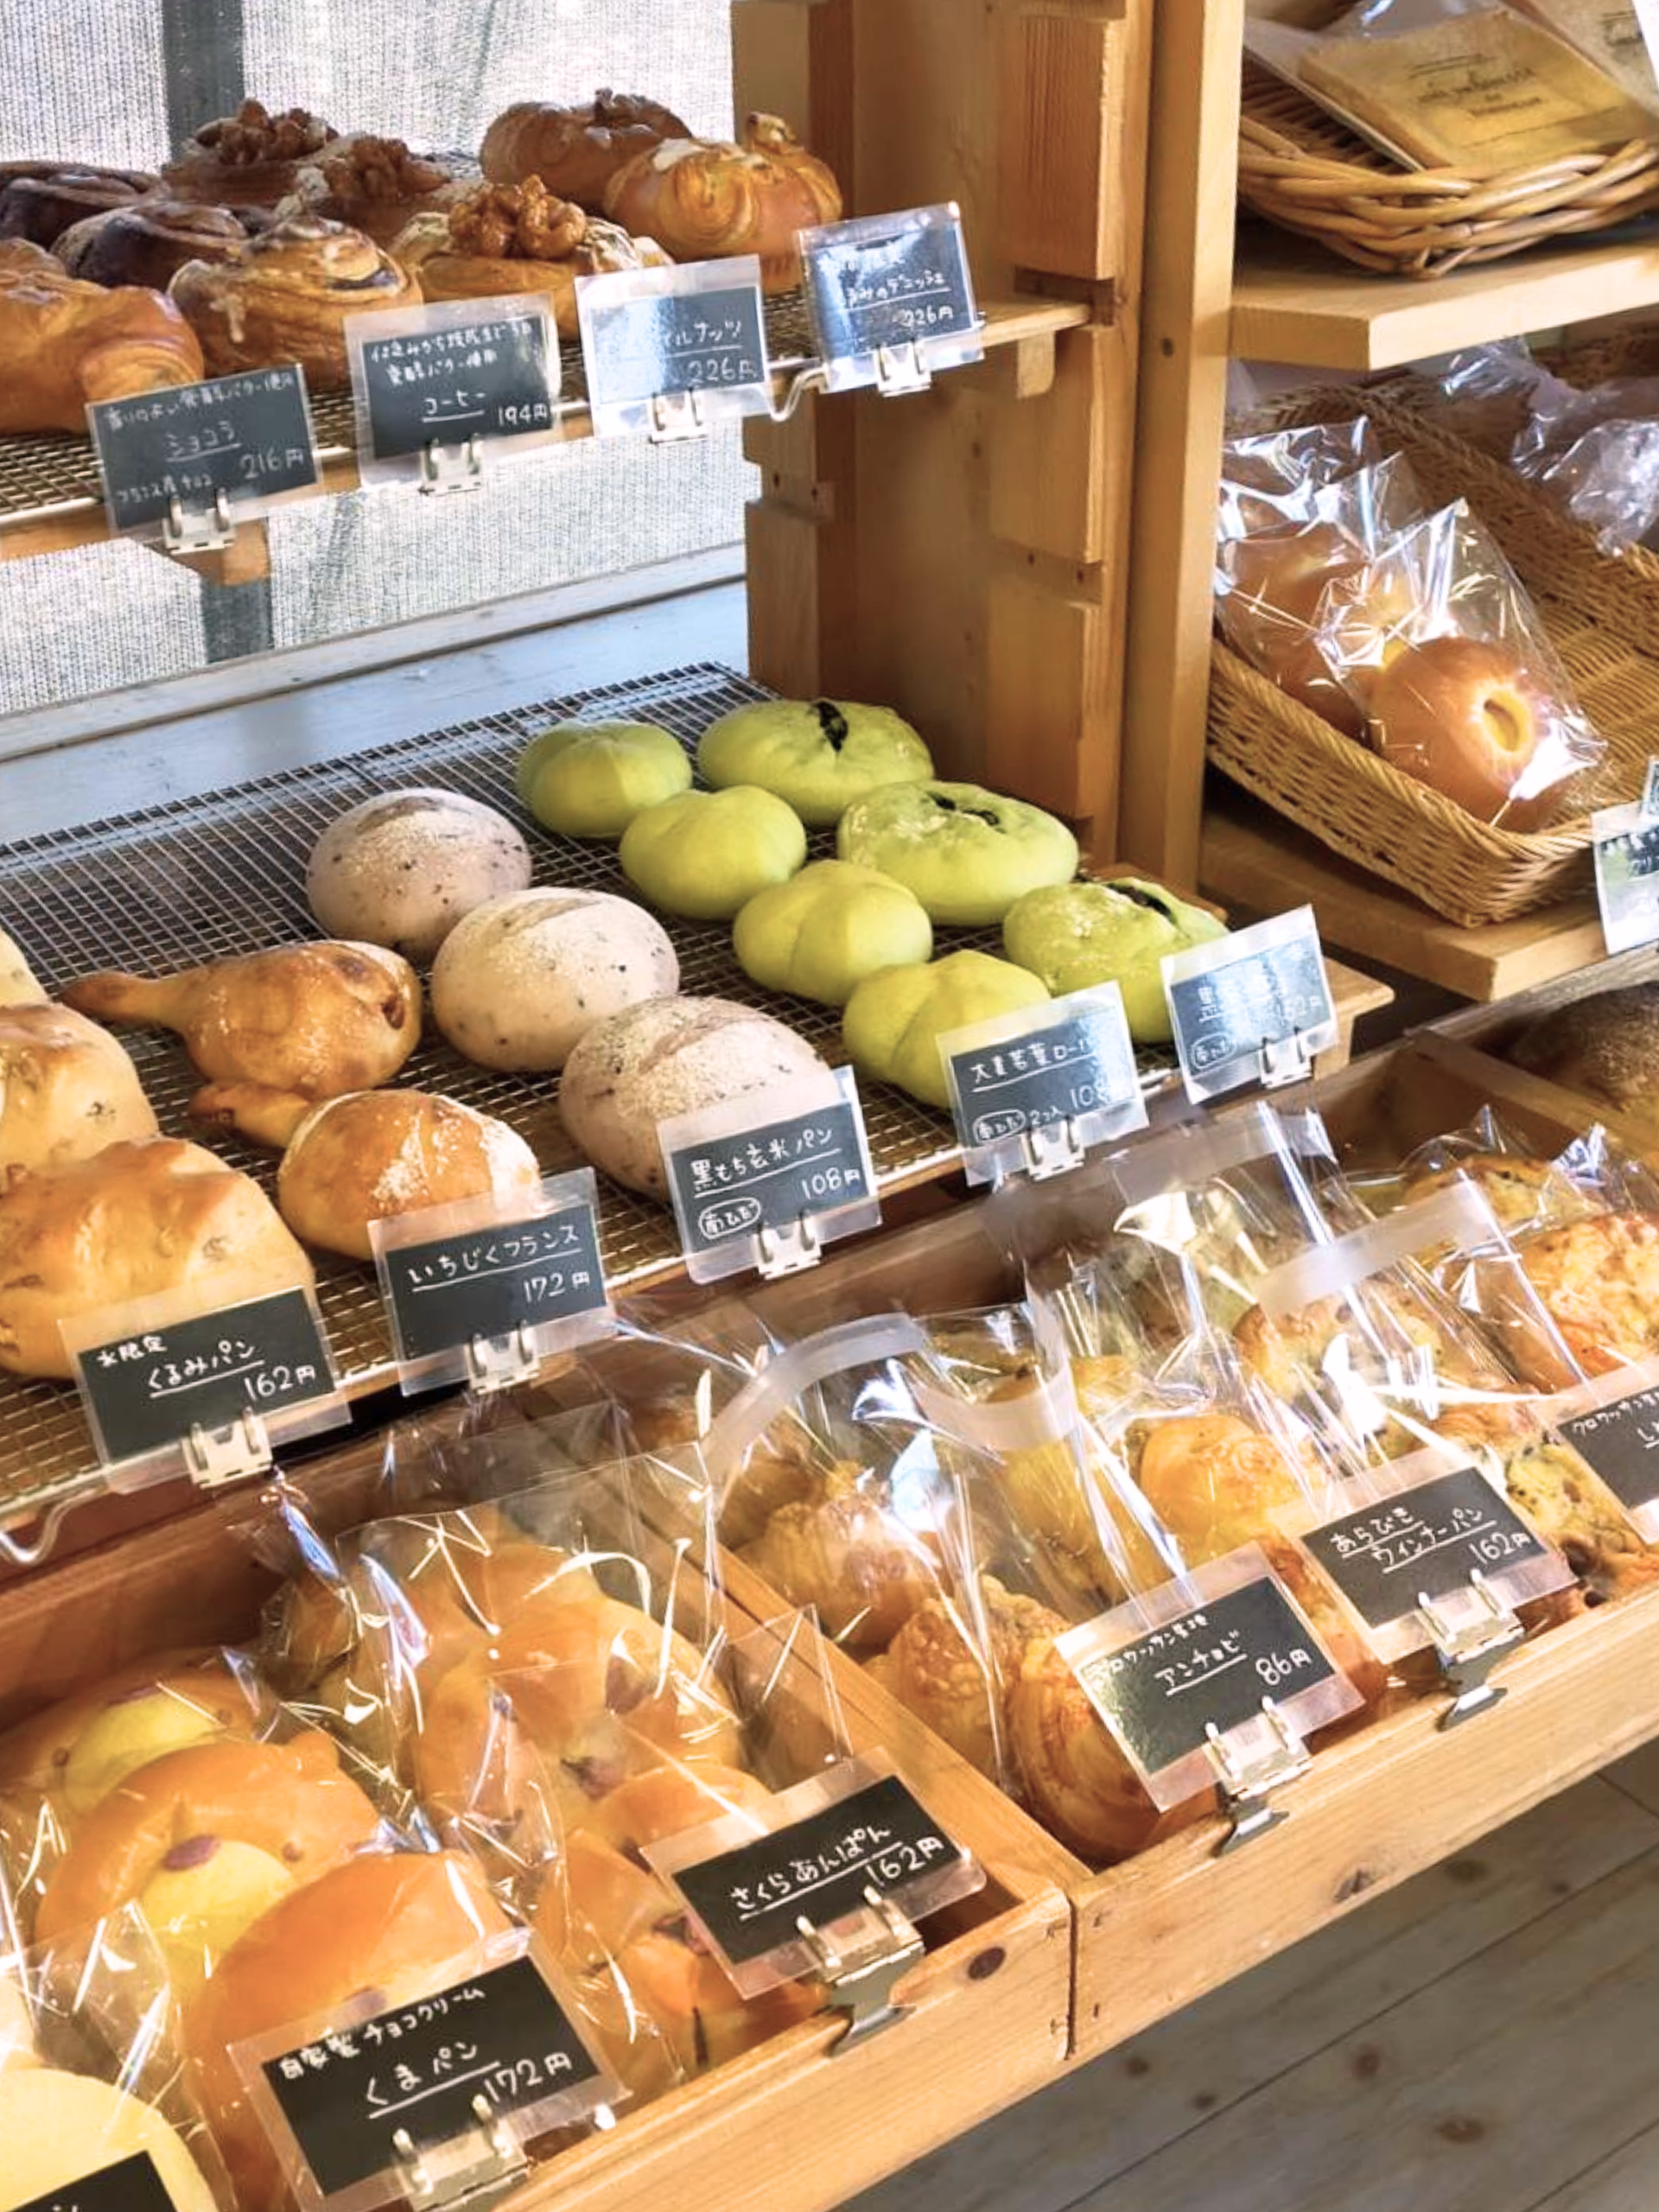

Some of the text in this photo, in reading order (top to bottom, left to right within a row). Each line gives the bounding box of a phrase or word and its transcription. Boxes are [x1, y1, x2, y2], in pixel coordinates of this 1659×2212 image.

[688, 357, 757, 384] 226円
[424, 389, 486, 415] コーヒー
[499, 402, 548, 426] 194円
[167, 420, 235, 455] ショコラ
[239, 447, 303, 479] 216円
[691, 1128, 832, 1191] 黒もち玄米パン
[802, 1167, 860, 1199] 108円
[408, 1224, 580, 1283] いちじくフランス
[524, 1271, 590, 1302] 172円
[149, 1340, 256, 1389] くるみパン
[245, 1364, 316, 1401] 162円
[1331, 1507, 1414, 1554] あらびき
[1470, 1531, 1530, 1565] 162円
[1154, 1630, 1240, 1687] アンチョビ
[1255, 1648, 1313, 1686] 86円
[731, 1824, 891, 1910] さくらあんぱん
[866, 1835, 944, 1887] 162円
[484, 2051, 574, 2101] 172円
